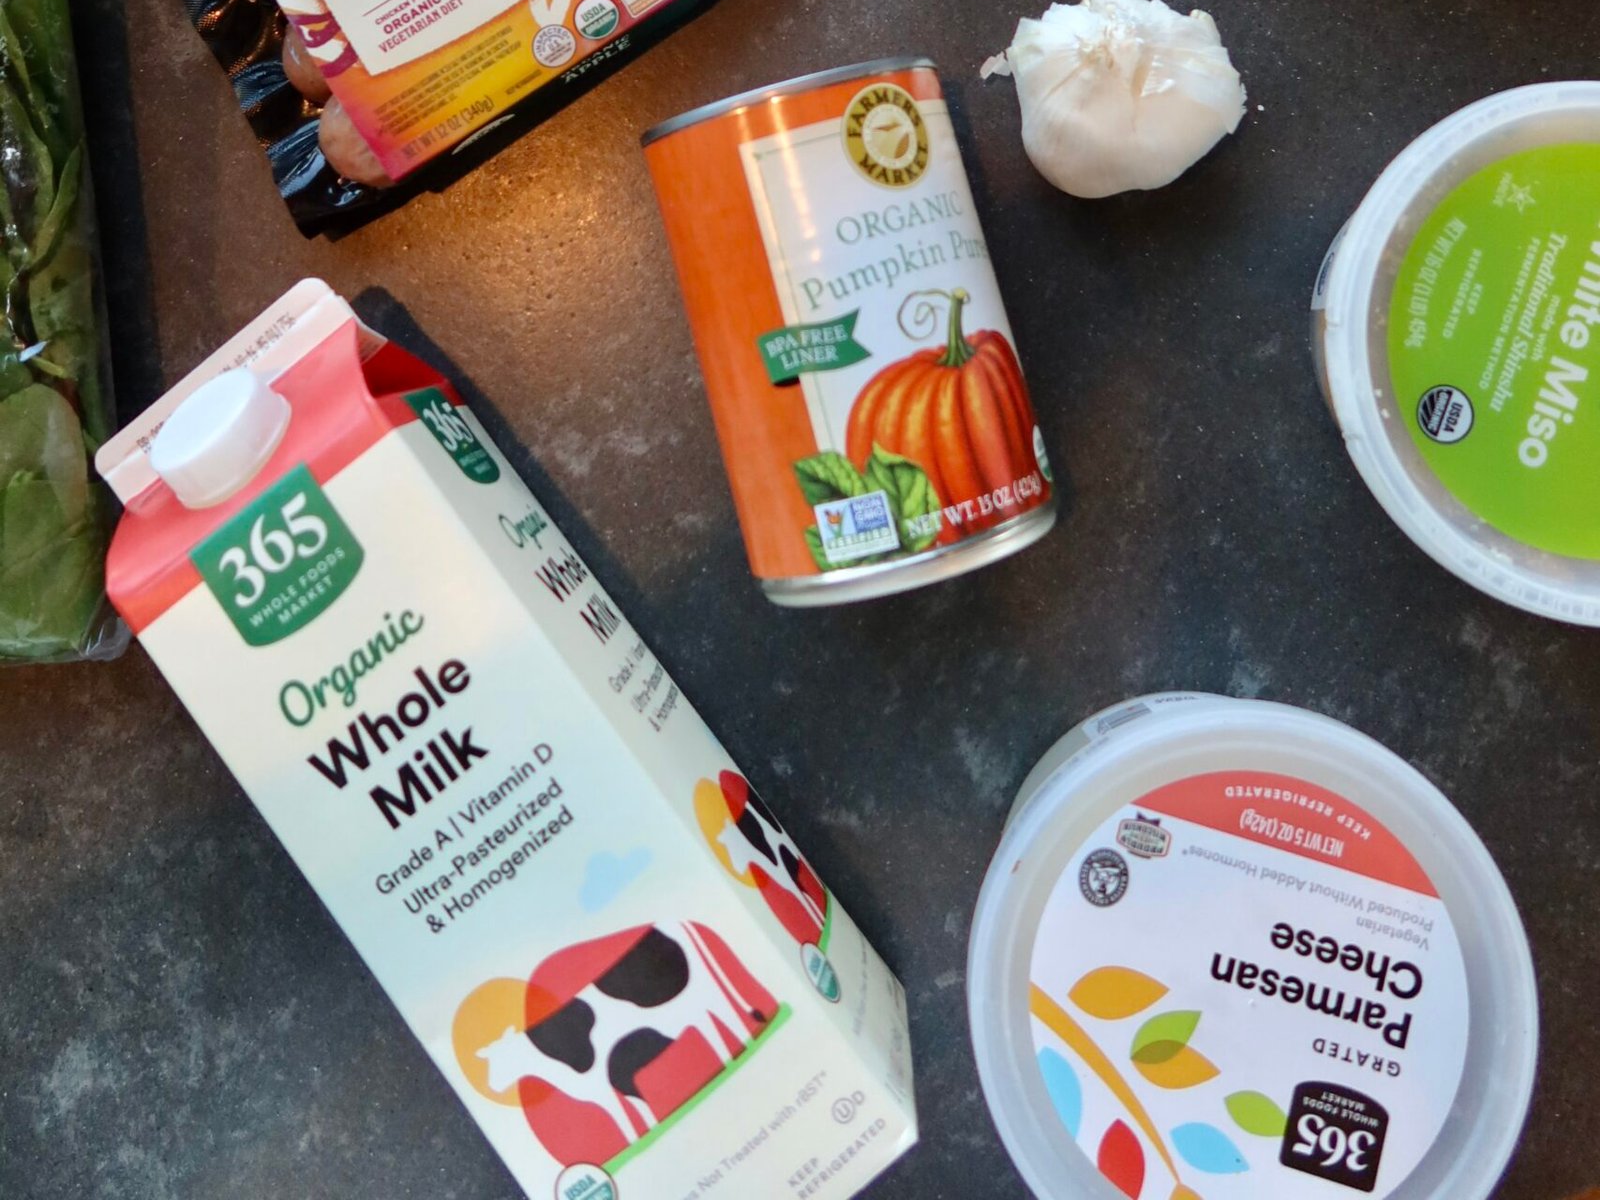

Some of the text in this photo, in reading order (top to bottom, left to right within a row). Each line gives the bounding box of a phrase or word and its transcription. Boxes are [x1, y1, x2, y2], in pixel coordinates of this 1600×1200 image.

[375, 0, 411, 25] CHICKEN
[378, 9, 442, 53] VEGETARIAN
[581, 3, 606, 23] USDA
[444, 95, 495, 131] OZ (340g)
[836, 190, 964, 244] ORGANIC
[1447, 218, 1466, 241] NET
[801, 240, 947, 311] Pumpkin
[1442, 249, 1482, 338] REFRIGERATED
[1467, 283, 1483, 315] KEEP
[799, 325, 847, 347] FREE
[1479, 238, 1541, 390] FERMENTATION METHOD
[1490, 233, 1566, 412] Traditional Shinshu
[780, 345, 837, 370] LINER
[1531, 333, 1547, 361] with
[1443, 402, 1463, 433] USDA
[1519, 357, 1588, 467] Miso
[219, 493, 325, 605] 365
[249, 547, 345, 627] WHOLE FOODS
[278, 575, 332, 623] MARKET
[280, 613, 422, 725] Organic
[308, 661, 470, 788] Whole
[370, 730, 487, 829] Milk
[375, 743, 553, 895] Grade A Vitamin D
[1225, 786, 1371, 840] KEEP REFRIGERATED
[1239, 808, 1344, 858] NET WT 5 OZ (142g)
[403, 778, 562, 914] Ultra-Pasteurized
[423, 805, 574, 935] & Homogenized
[1259, 867, 1434, 933] Produced Without Added
[1356, 916, 1430, 951] Vegetarian
[1271, 923, 1423, 999] Cheese
[1211, 954, 1412, 1049] Parmesan
[1312, 1038, 1401, 1077] GRATED
[1303, 1096, 1378, 1127] WHOLE FOODS
[697, 1169, 724, 1192] Not
[719, 1127, 770, 1170] Treated
[767, 1105, 796, 1131] with
[1293, 1114, 1375, 1169] 365
[788, 1158, 818, 1188] KEEP
